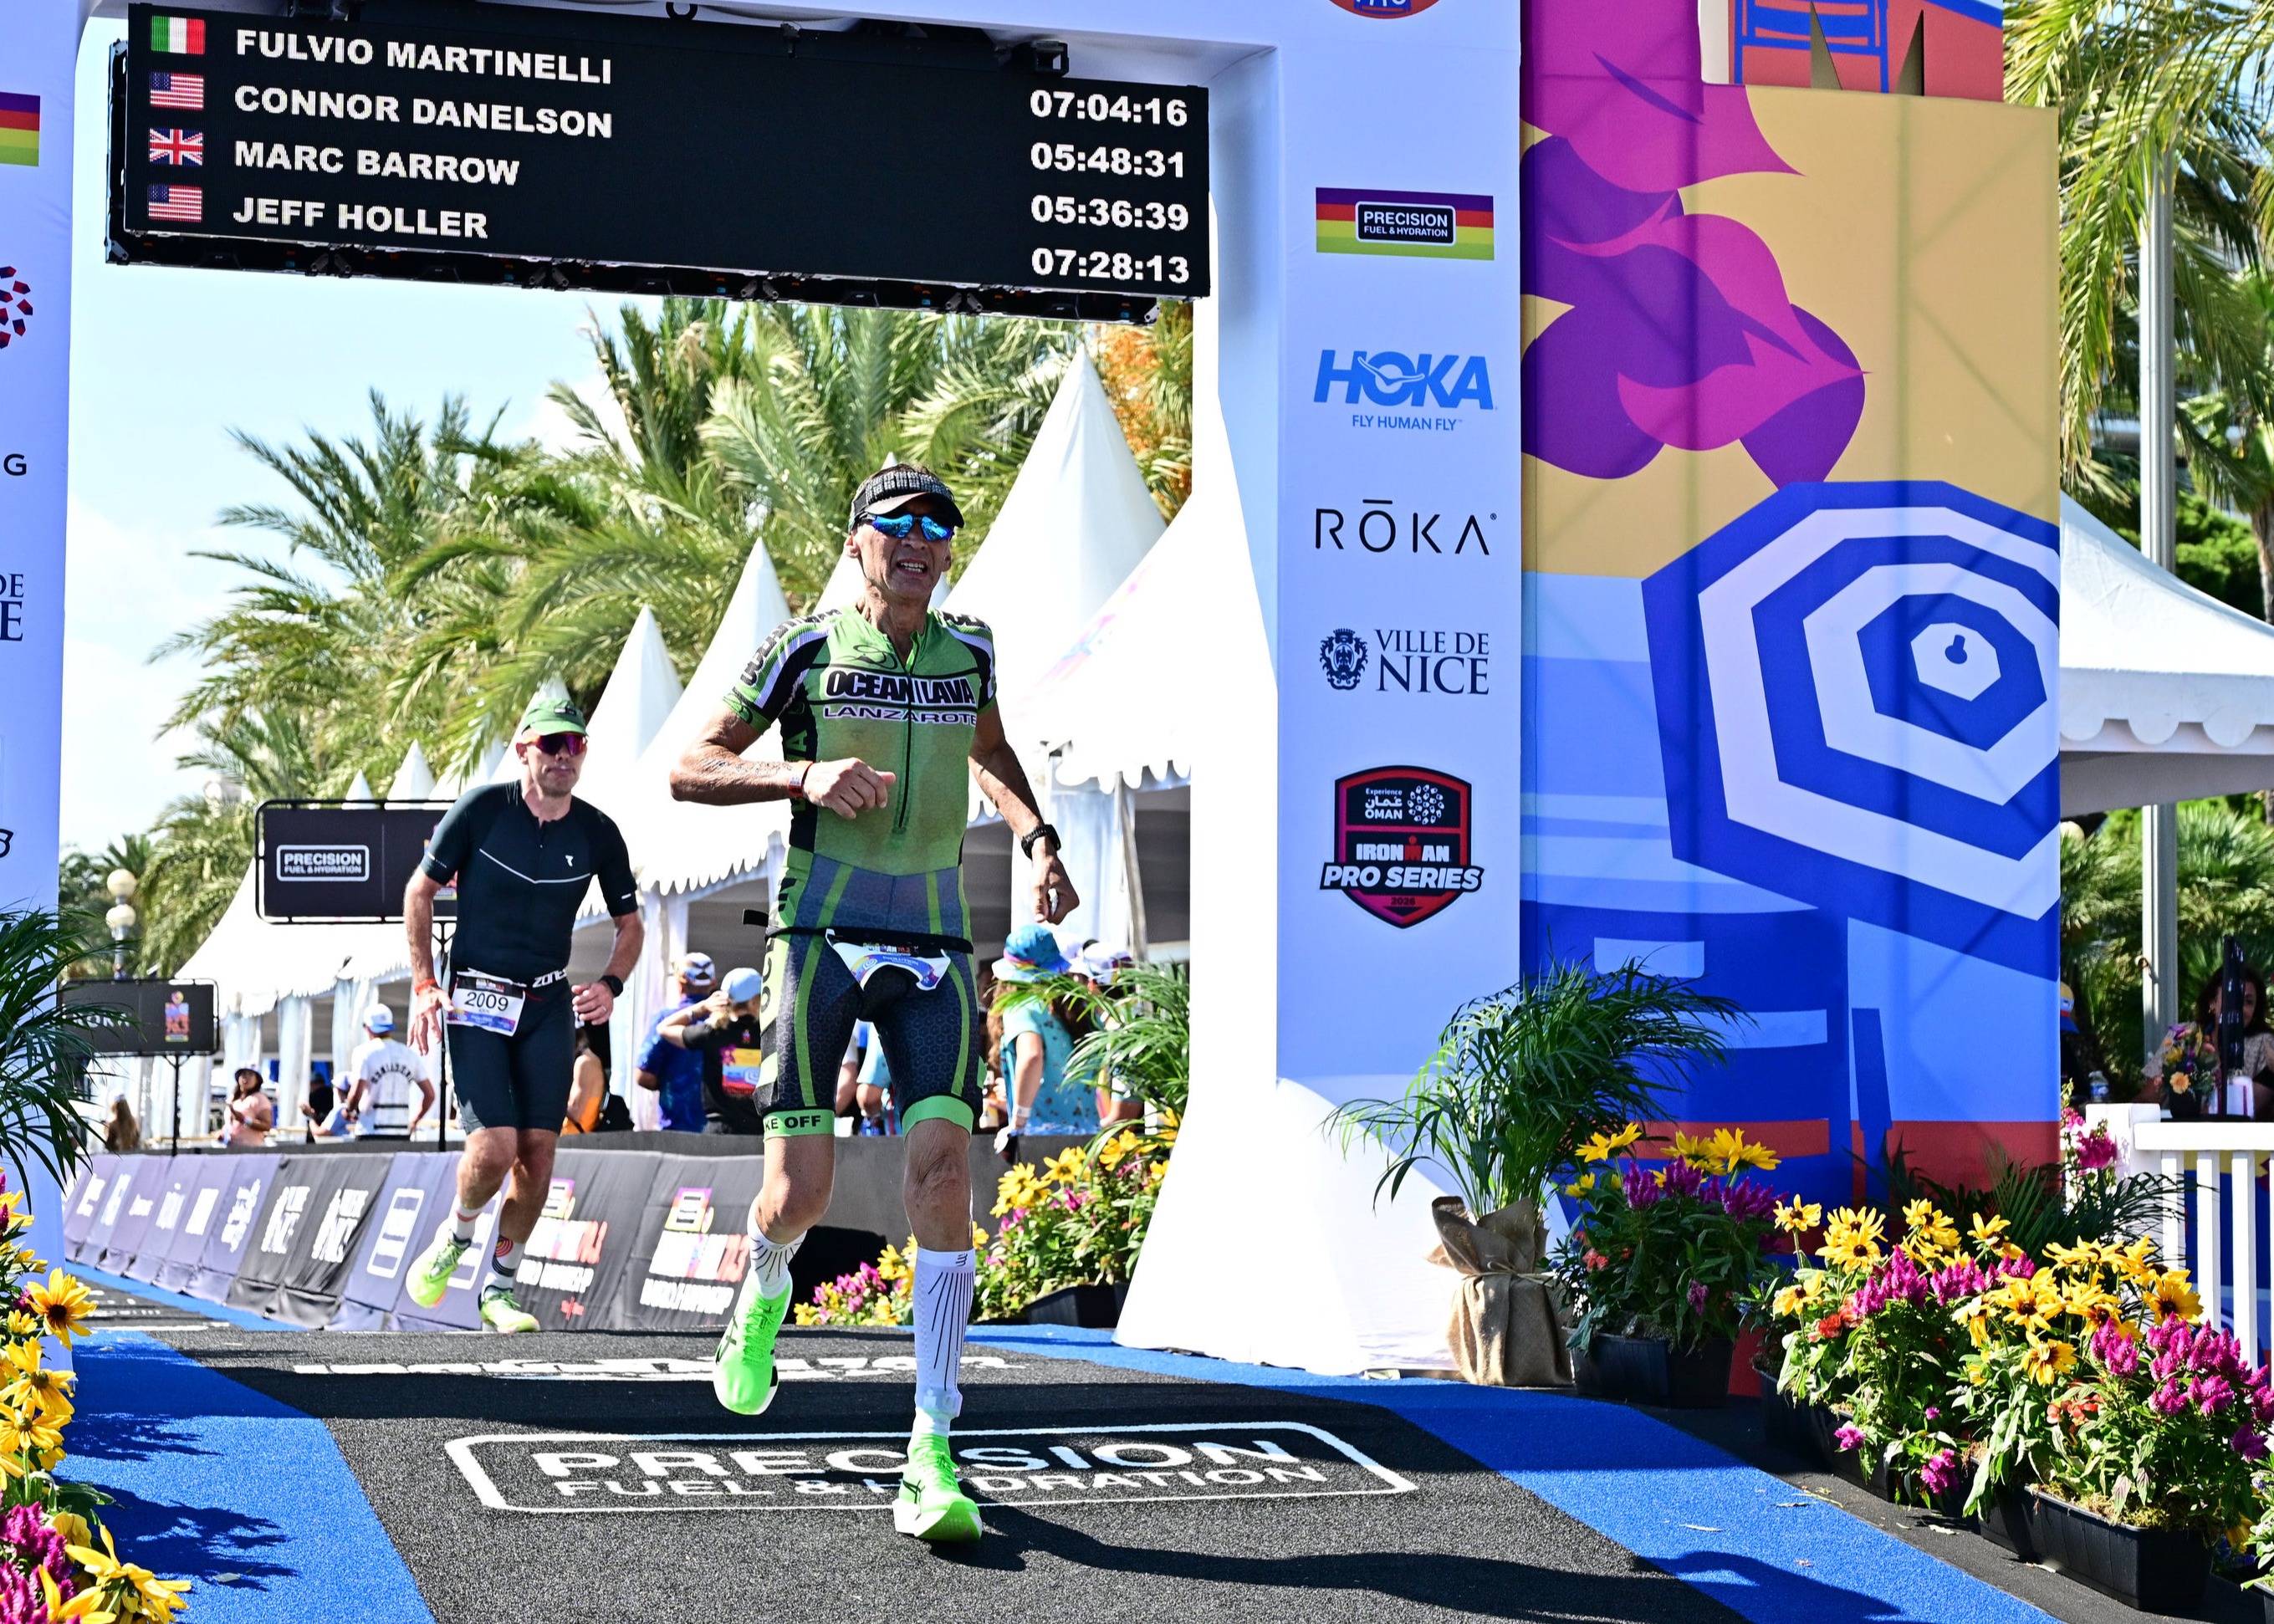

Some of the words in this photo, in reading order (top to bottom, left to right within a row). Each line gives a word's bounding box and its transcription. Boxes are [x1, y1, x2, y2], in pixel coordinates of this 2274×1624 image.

[237, 29, 374, 65] FULVIO
[387, 42, 611, 84] MARTINELLI
[234, 86, 401, 123] CONNOR
[412, 98, 612, 138] DANELSON
[1030, 89, 1188, 126] 07:04:16
[234, 141, 344, 174] MARC
[356, 149, 519, 186] BARROW
[1030, 142, 1183, 178] 05:48:31
[233, 197, 325, 227] JEFF
[338, 204, 488, 239] HOLLER
[1030, 195, 1188, 231] 05:36:39
[1363, 212, 1448, 227] PRECISION
[1364, 226, 1387, 234] FUEL
[1397, 227, 1448, 237] HYDRATION
[1031, 248, 1189, 283] 07:28:13
[1314, 350, 1494, 410] HOKA
[1352, 415, 1374, 427] FLY
[1377, 416, 1432, 430] HUMAN
[1435, 418, 1457, 431] FLY
[1374, 629, 1446, 653] VILLE
[1454, 631, 1490, 655] DE
[1375, 654, 1490, 695] NICE
[824, 707, 977, 727] LANZAROTE
[1365, 809, 1403, 820] OMAN
[284, 853, 362, 866] PRECISION
[1356, 835, 1451, 862] IRONMAN
[284, 866, 306, 874] FUEL
[314, 866, 362, 874] HYDRATION
[1323, 866, 1381, 887] PRO
[1385, 866, 1480, 890] SERIES
[464, 992, 508, 1011] 2009
[784, 1115, 821, 1129] OFF
[531, 1439, 1300, 1477] PRECSION
[553, 1479, 774, 1496] FUEL
[794, 1479, 850, 1494] &
[863, 1466, 1327, 1494] HDRATION
